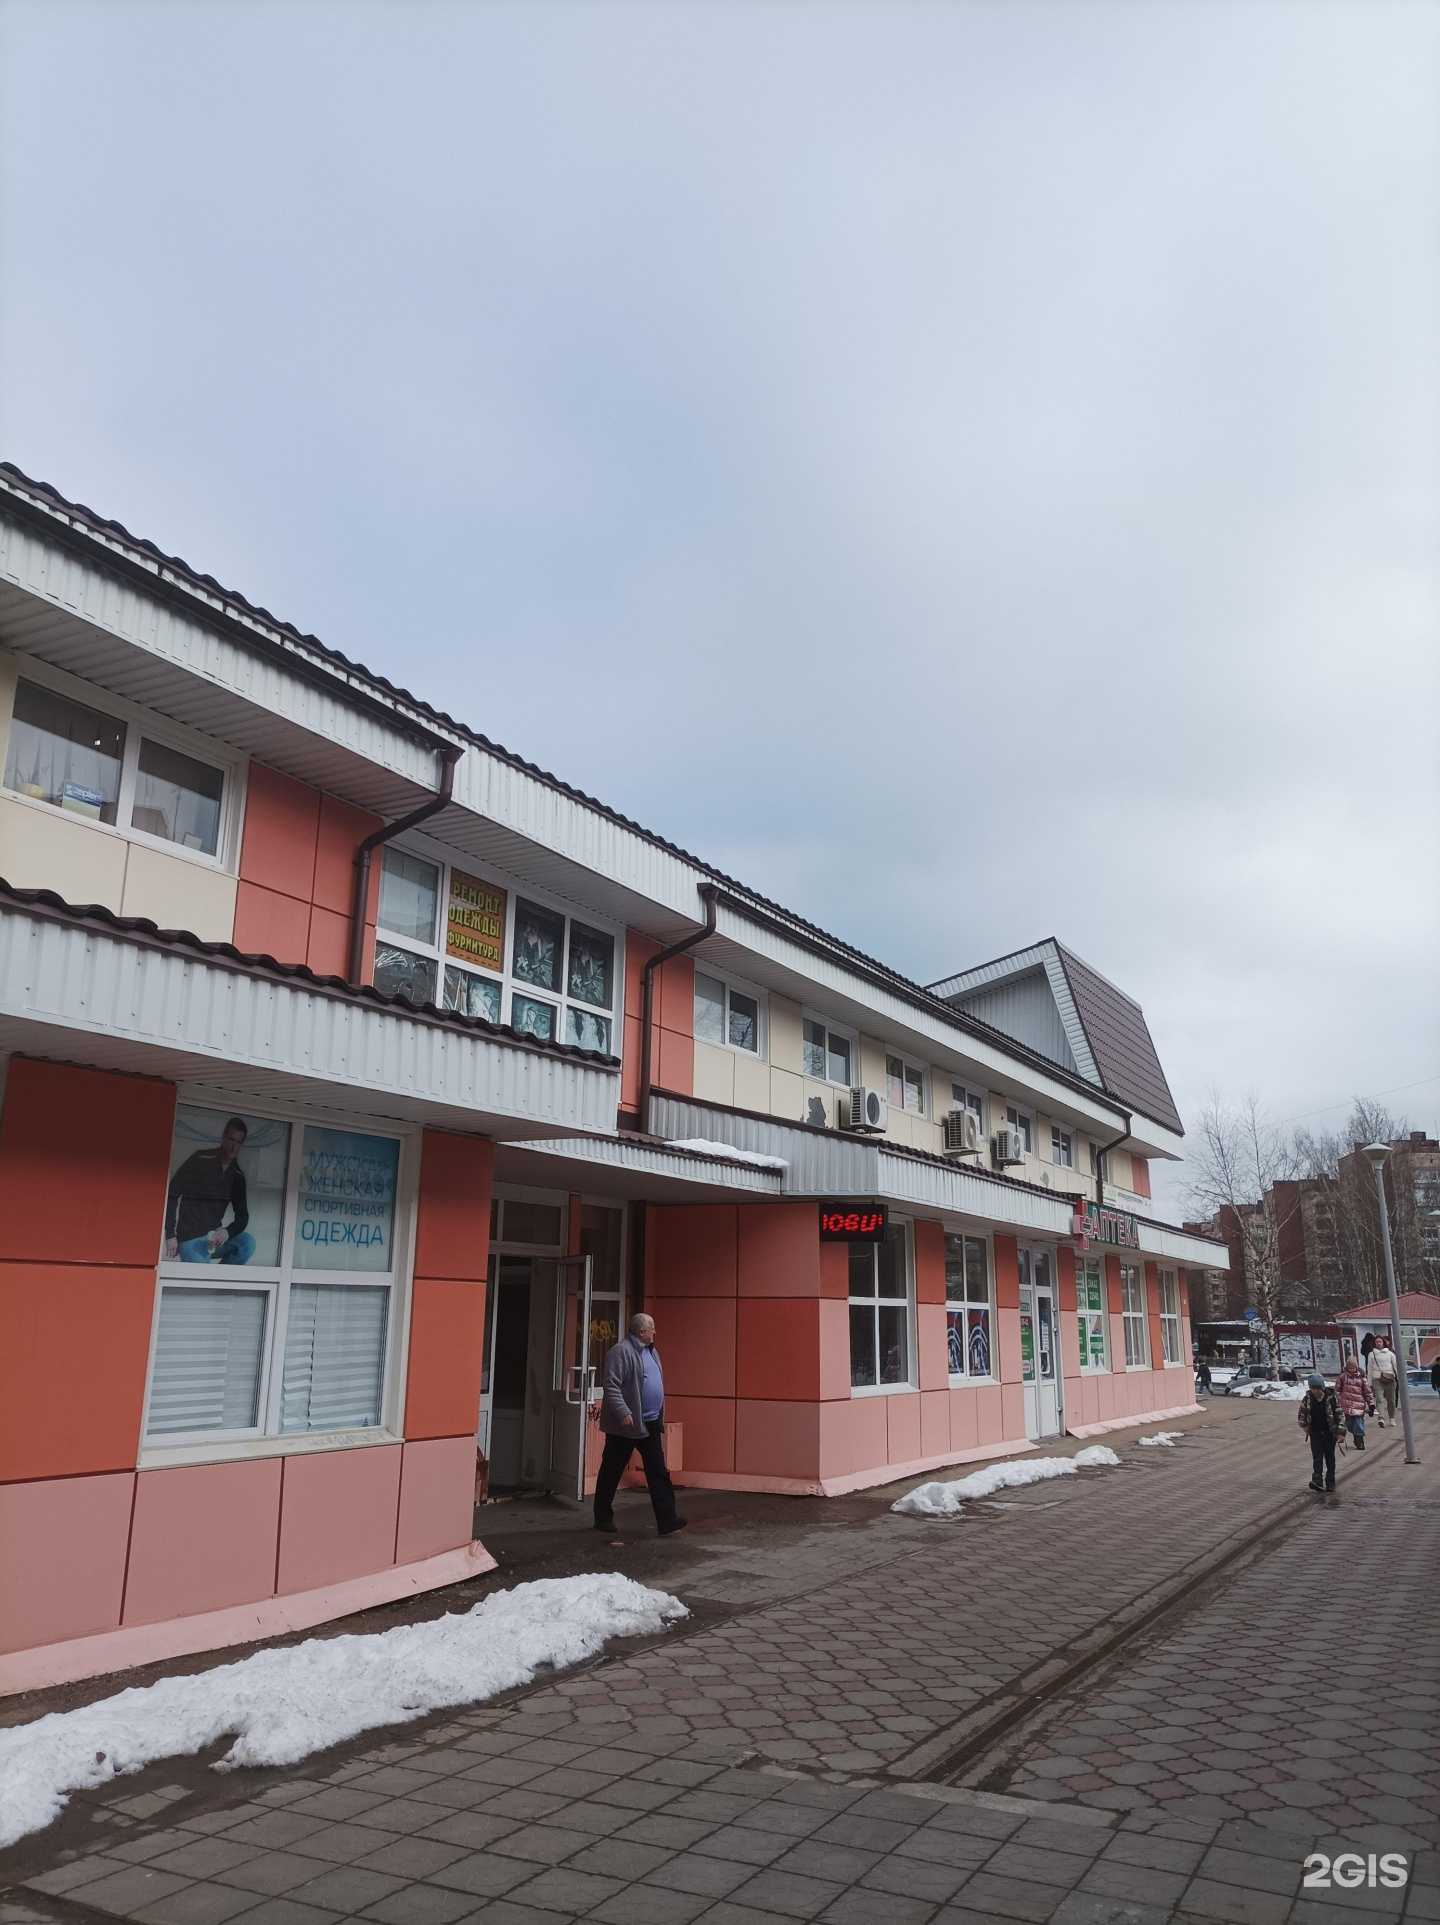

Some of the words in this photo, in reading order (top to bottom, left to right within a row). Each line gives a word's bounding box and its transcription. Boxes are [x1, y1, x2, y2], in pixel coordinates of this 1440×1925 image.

[453, 880, 500, 914] РЕМОНТ
[448, 903, 500, 938] ОДЕЖДЫ
[447, 930, 499, 961] ФУРНИТУРА
[309, 1175, 385, 1199] ЖЕНСКАЯ
[304, 1199, 385, 1217] СПОРТИВНАЯ
[301, 1219, 384, 1248] ОДЕЖДА
[1091, 1206, 1140, 1249] АПТЕКА
